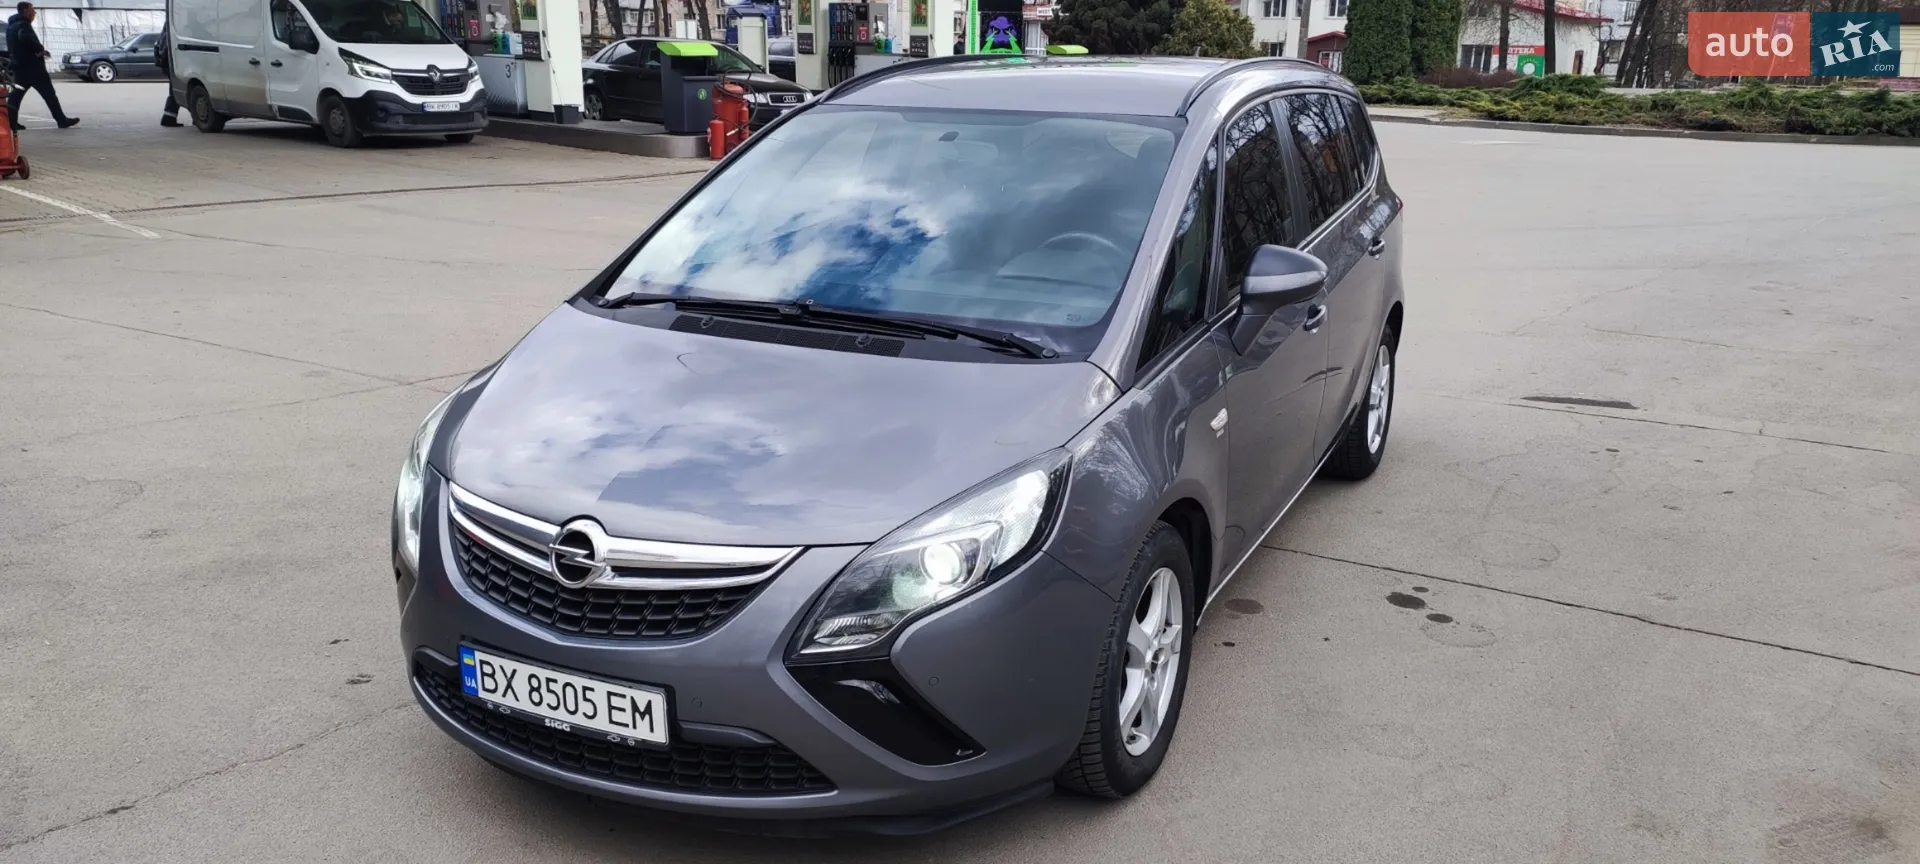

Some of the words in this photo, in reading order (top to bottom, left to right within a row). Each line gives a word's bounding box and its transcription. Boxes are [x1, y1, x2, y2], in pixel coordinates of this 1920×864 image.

[505, 64, 512, 78] 3
[465, 676, 477, 689] UA
[479, 659, 520, 703] BX
[527, 673, 598, 720] 8505
[607, 690, 655, 734] EM
